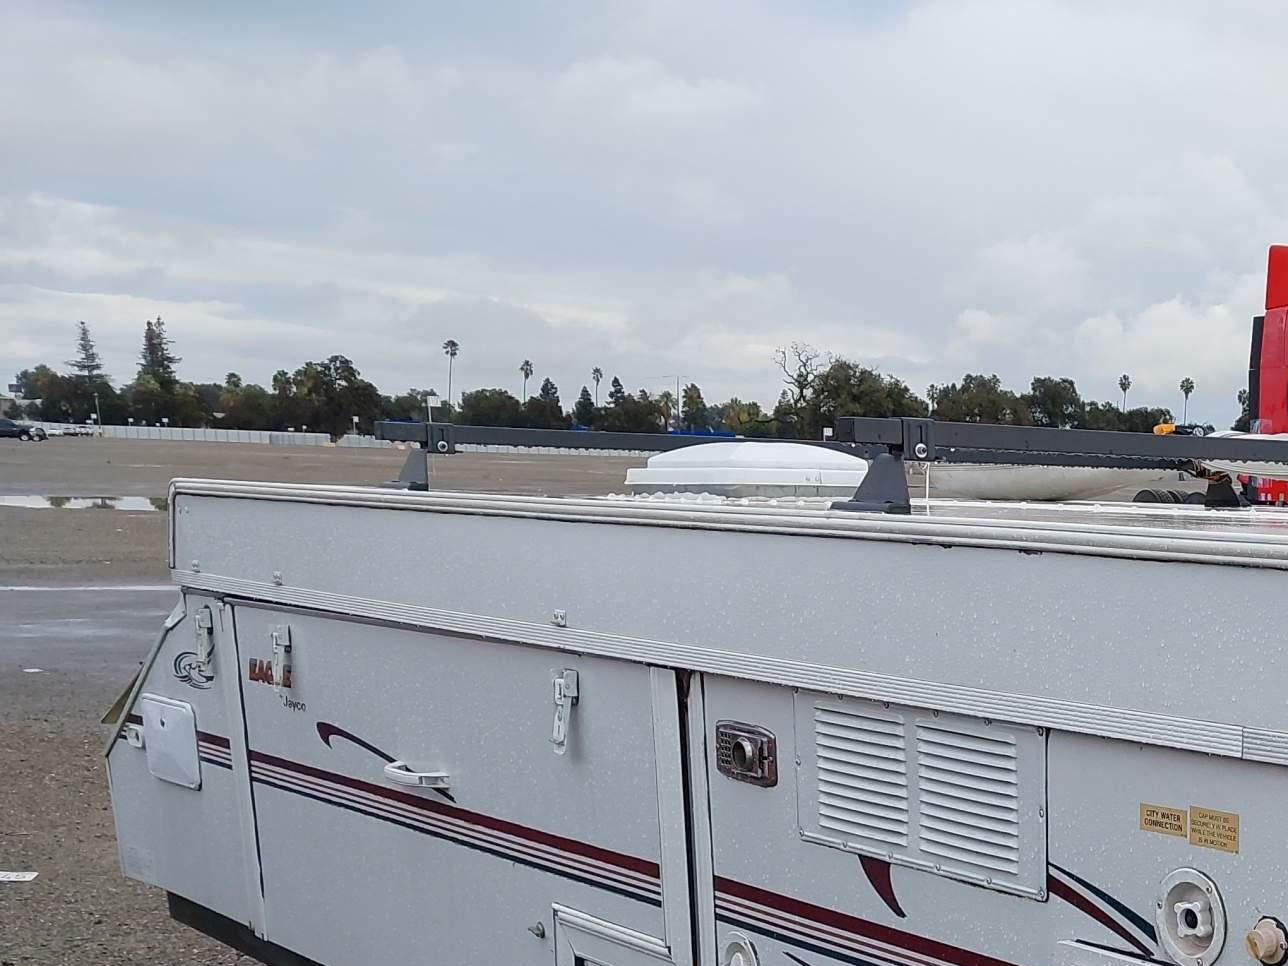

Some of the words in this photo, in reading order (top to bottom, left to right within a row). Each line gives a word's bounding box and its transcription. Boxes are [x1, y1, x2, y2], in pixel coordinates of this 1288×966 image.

[283, 696, 307, 712] Jayco
[1146, 810, 1159, 818] CITY
[1160, 811, 1181, 823] WATER
[1144, 817, 1183, 832] CONNECTION
